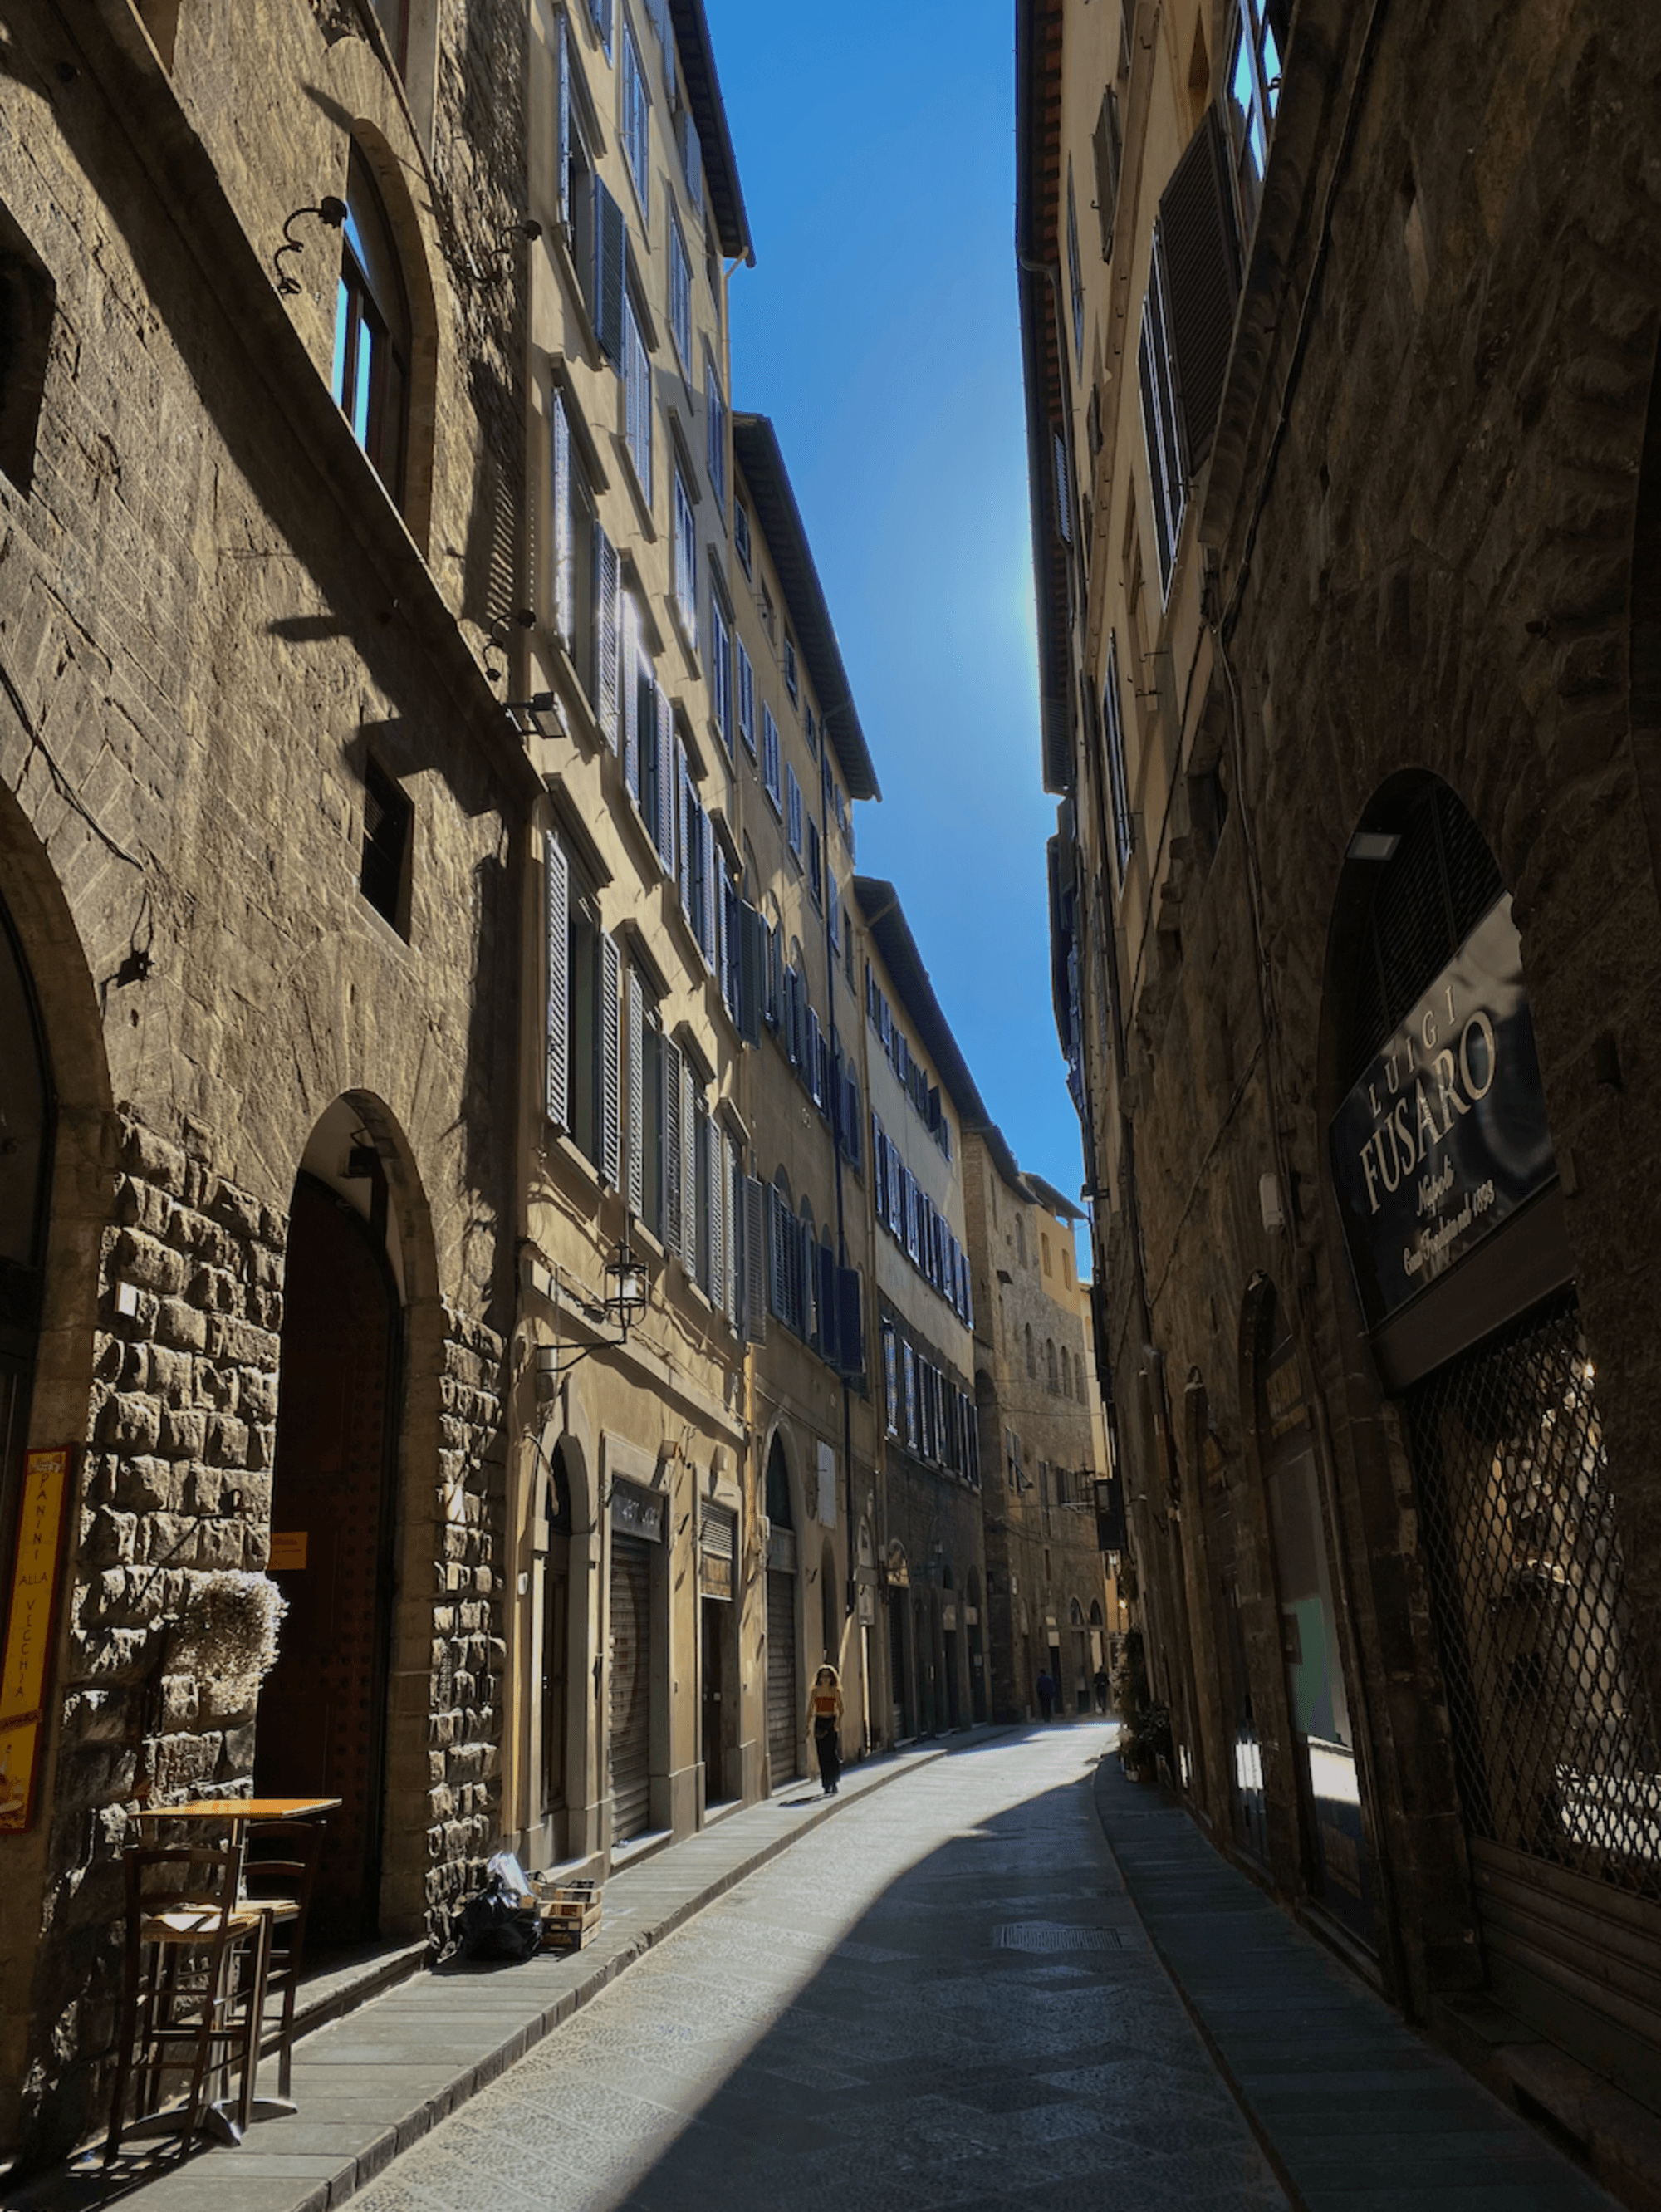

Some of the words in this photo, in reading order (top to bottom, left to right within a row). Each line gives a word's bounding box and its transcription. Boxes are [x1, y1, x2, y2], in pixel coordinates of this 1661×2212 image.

[1369, 986, 1456, 1118] LUIGI
[1359, 1011, 1496, 1214] FUSARO
[1416, 1155, 1454, 1216] Napoli
[33, 1473, 49, 1560] PANINI
[18, 1572, 47, 1586] ALLA
[16, 1599, 36, 1697] VECCHIA
